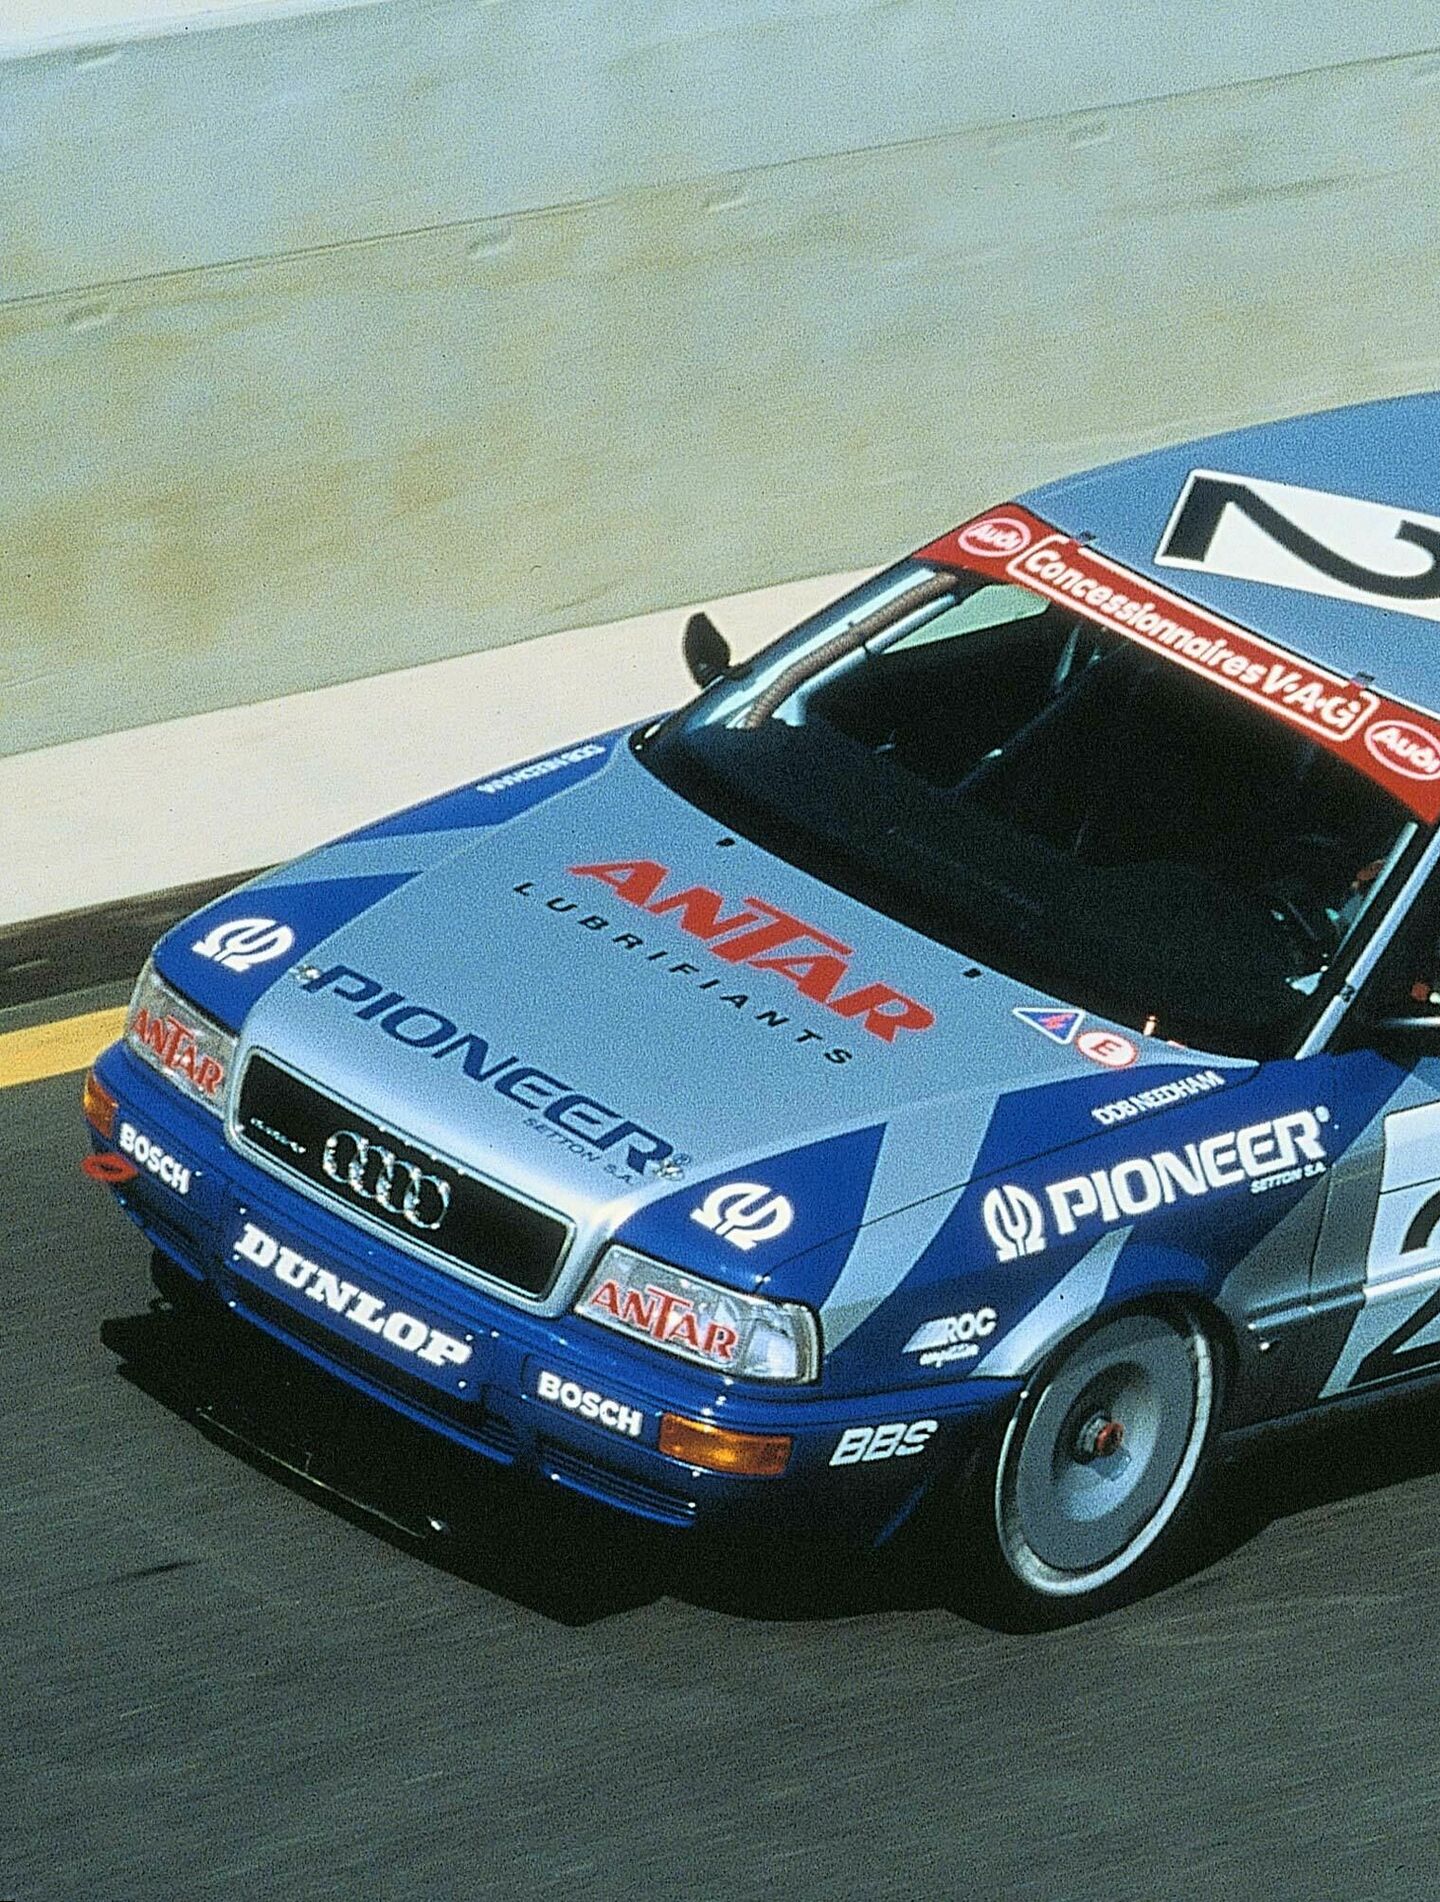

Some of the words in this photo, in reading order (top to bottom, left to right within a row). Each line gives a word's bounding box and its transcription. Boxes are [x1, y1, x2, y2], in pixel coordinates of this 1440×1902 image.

[1025, 549, 1268, 689] Concessionnaires
[513, 881, 854, 1066] LUBRIFIANTS
[566, 858, 936, 1044] ANTAR
[130, 1007, 225, 1096] ANTAR
[1089, 1038, 1122, 1057] E
[1134, 1070, 1226, 1112] NEEDHAM
[119, 1121, 192, 1196] BOSCH
[523, 1117, 601, 1162] SETTON
[1250, 1166, 1303, 1194] SETTON
[233, 1222, 474, 1367] DUNLOP
[590, 1279, 739, 1360] ANTAR
[946, 1306, 998, 1344] ROC
[536, 1370, 643, 1438] BOSCH
[828, 1418, 939, 1467] BBS
